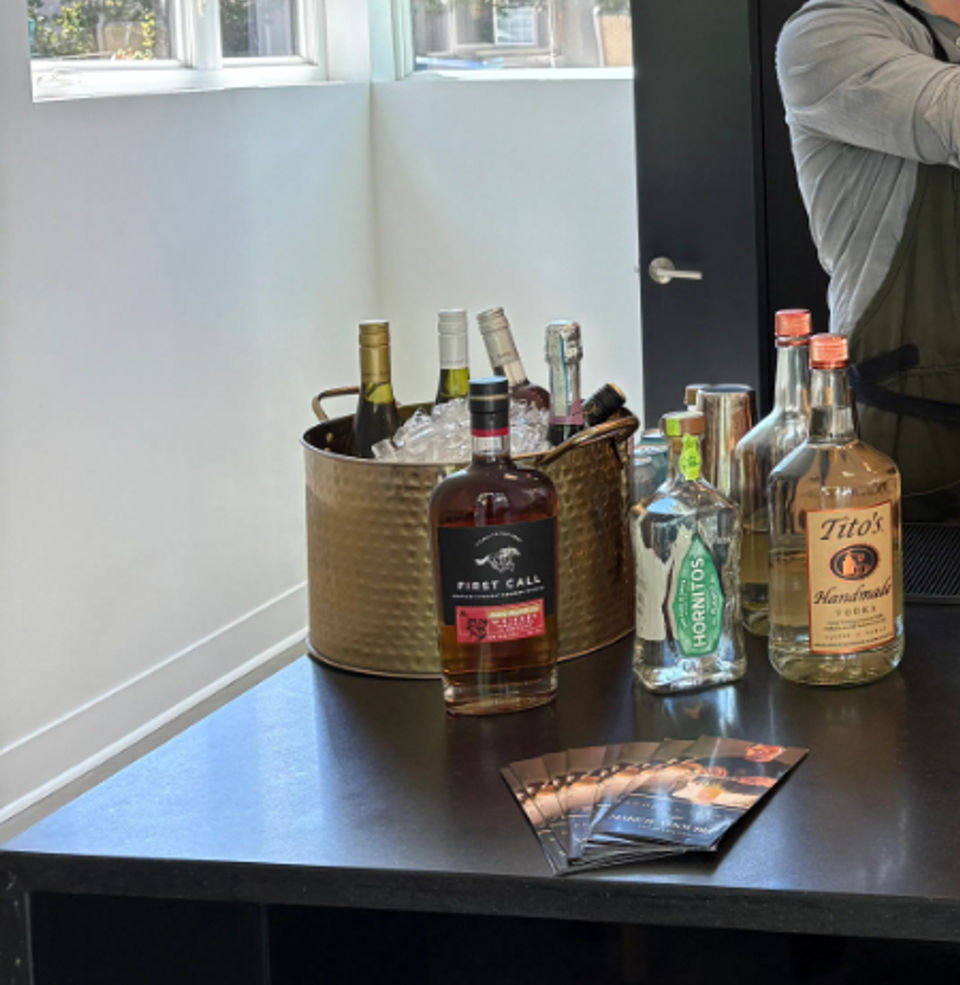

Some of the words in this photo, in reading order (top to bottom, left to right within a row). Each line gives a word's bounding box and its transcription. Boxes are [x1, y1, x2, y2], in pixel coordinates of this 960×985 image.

[820, 511, 884, 541] Tito's
[457, 580, 500, 590] FIRST
[505, 574, 542, 589] CALL
[813, 577, 893, 605] Handmade
[690, 557, 707, 648] HORNITOS
